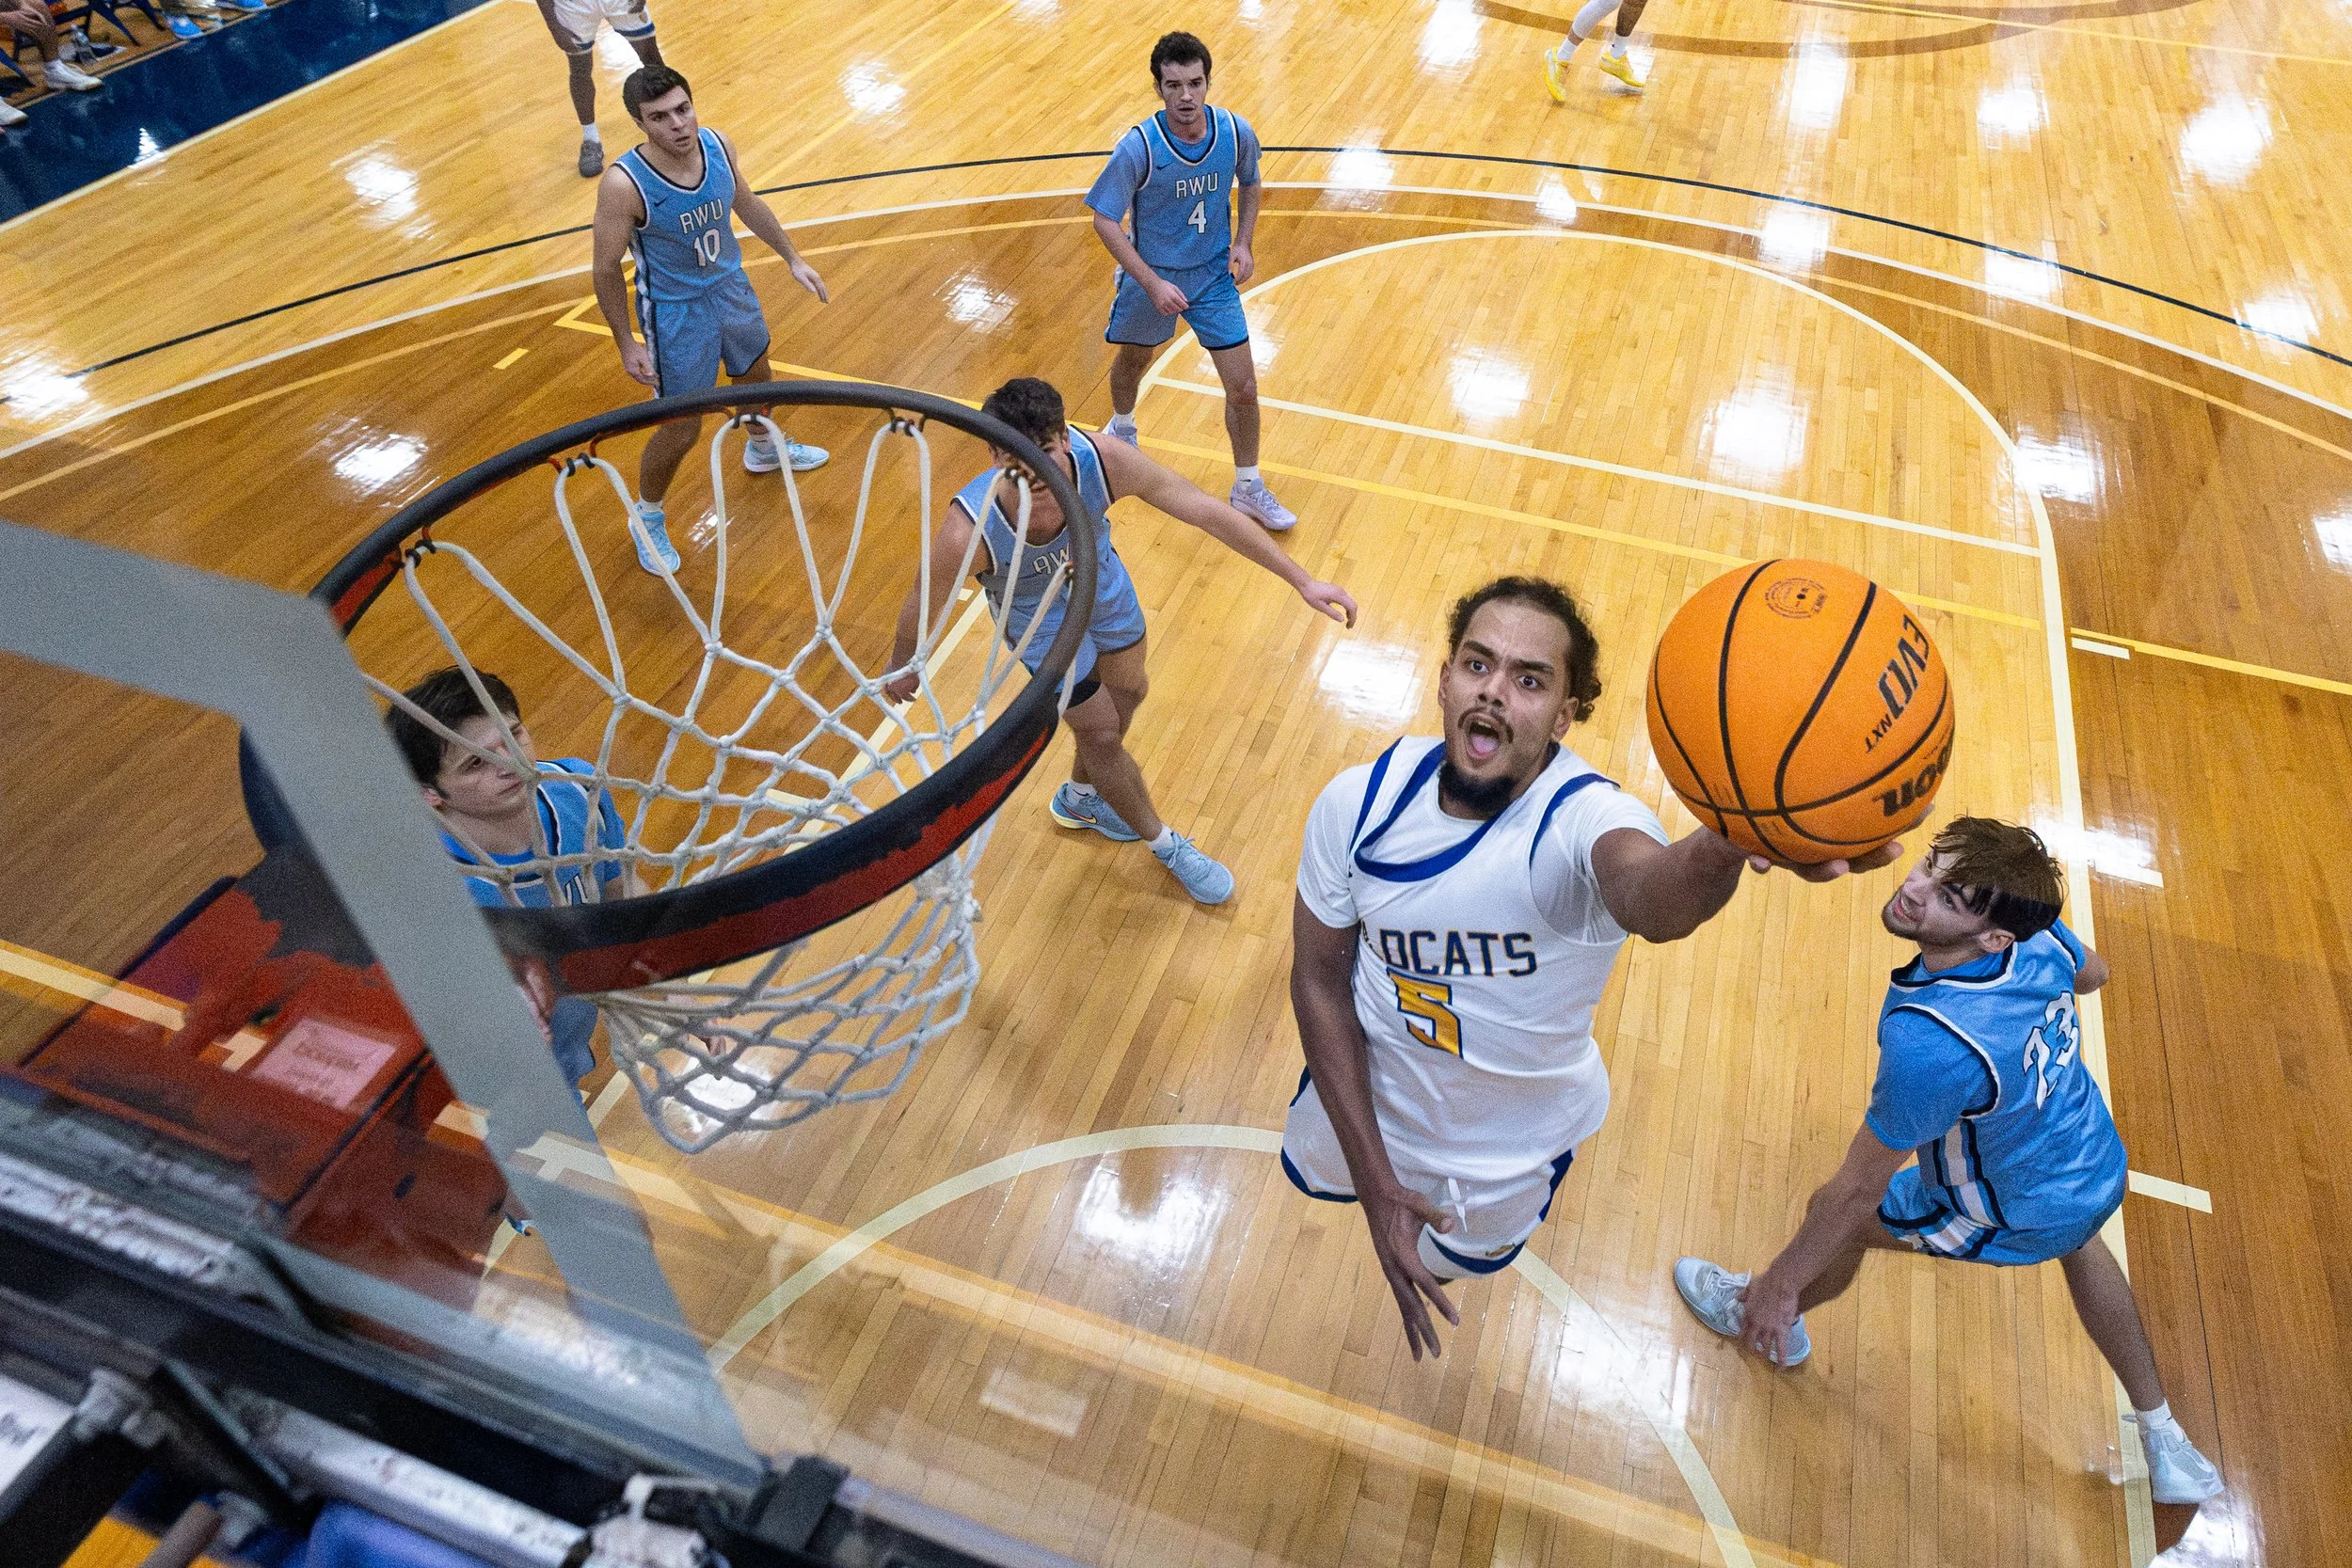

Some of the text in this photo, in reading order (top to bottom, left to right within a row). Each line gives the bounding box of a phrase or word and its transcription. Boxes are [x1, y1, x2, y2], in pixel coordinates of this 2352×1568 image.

[1175, 172, 1218, 199] RWU
[678, 198, 724, 235] RWU
[1186, 199, 1208, 235] 4
[693, 228, 722, 267] 10
[1032, 542, 1071, 575] RW
[1865, 613, 1931, 754] EVO NXT
[1378, 927, 1538, 978] DCATS
[1385, 965, 1465, 1061] 5
